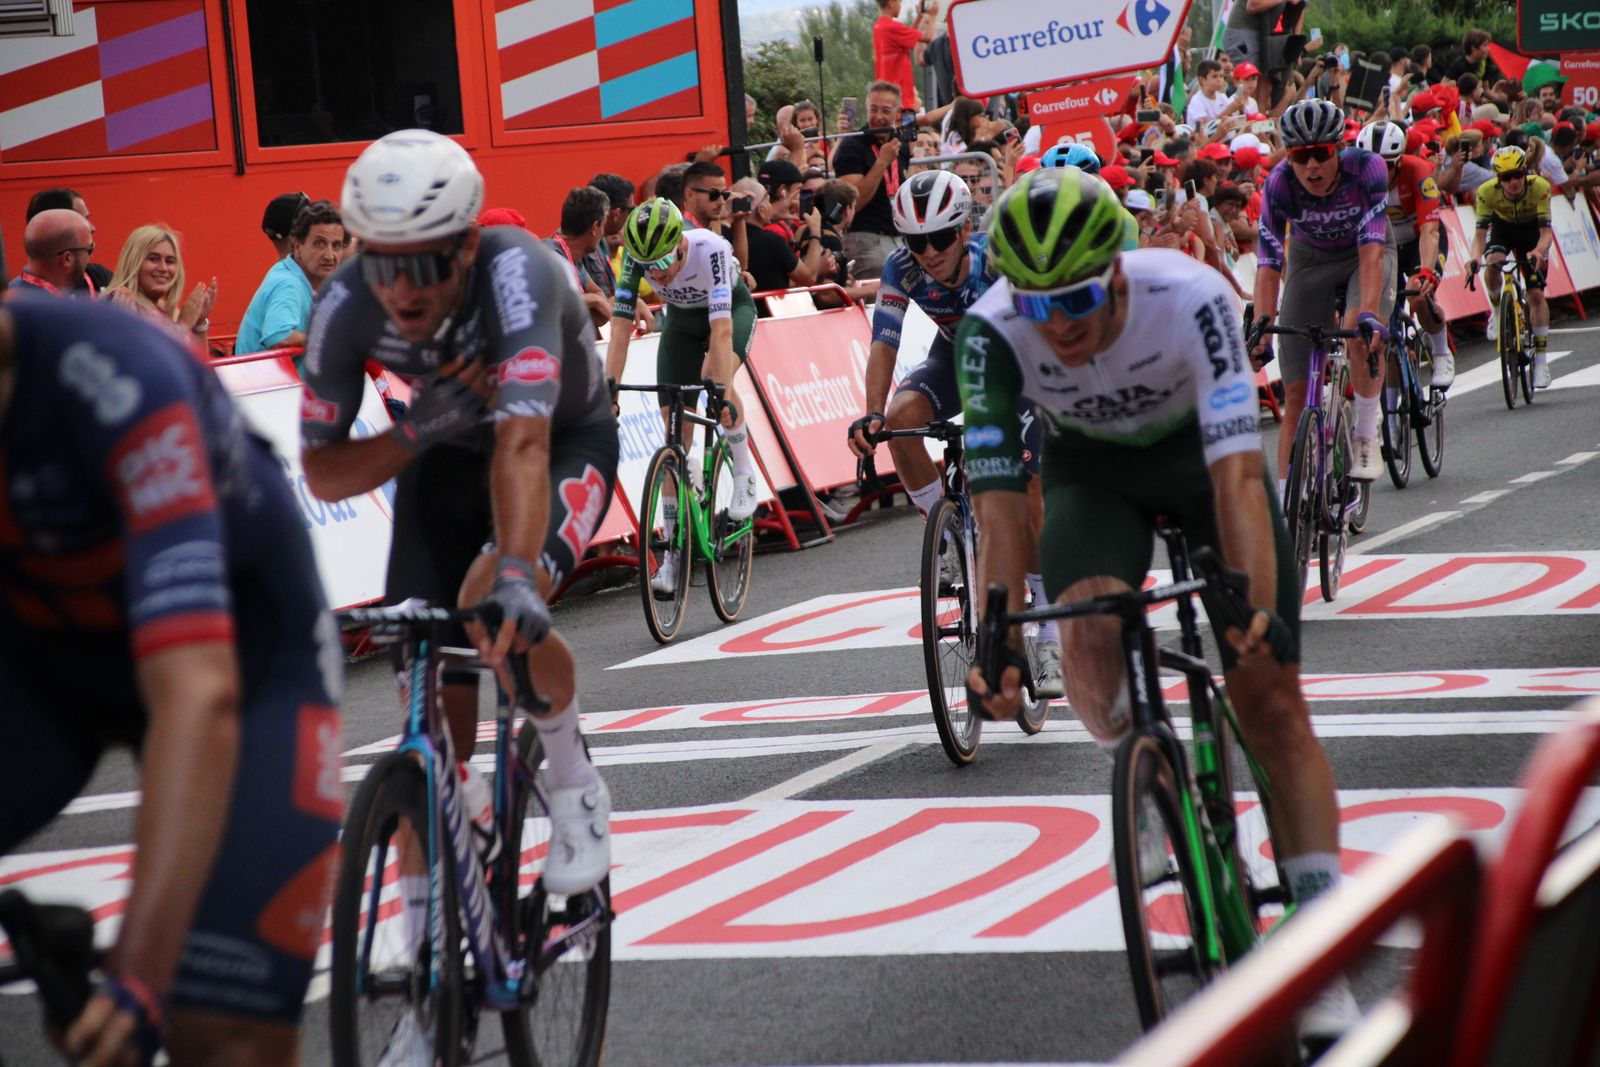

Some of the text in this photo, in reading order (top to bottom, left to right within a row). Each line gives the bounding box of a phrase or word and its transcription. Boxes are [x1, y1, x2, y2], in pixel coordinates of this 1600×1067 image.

[971, 18, 1105, 59] Carrefour
[1032, 94, 1091, 115] Carrefour
[1573, 86, 1599, 106] 50
[1293, 205, 1362, 223] Jayco
[709, 251, 722, 286] RGA
[1195, 303, 1229, 381] RGA
[1214, 293, 1245, 374] SEGUROS
[961, 333, 991, 414] ALEA
[767, 361, 861, 430] Carrefour
